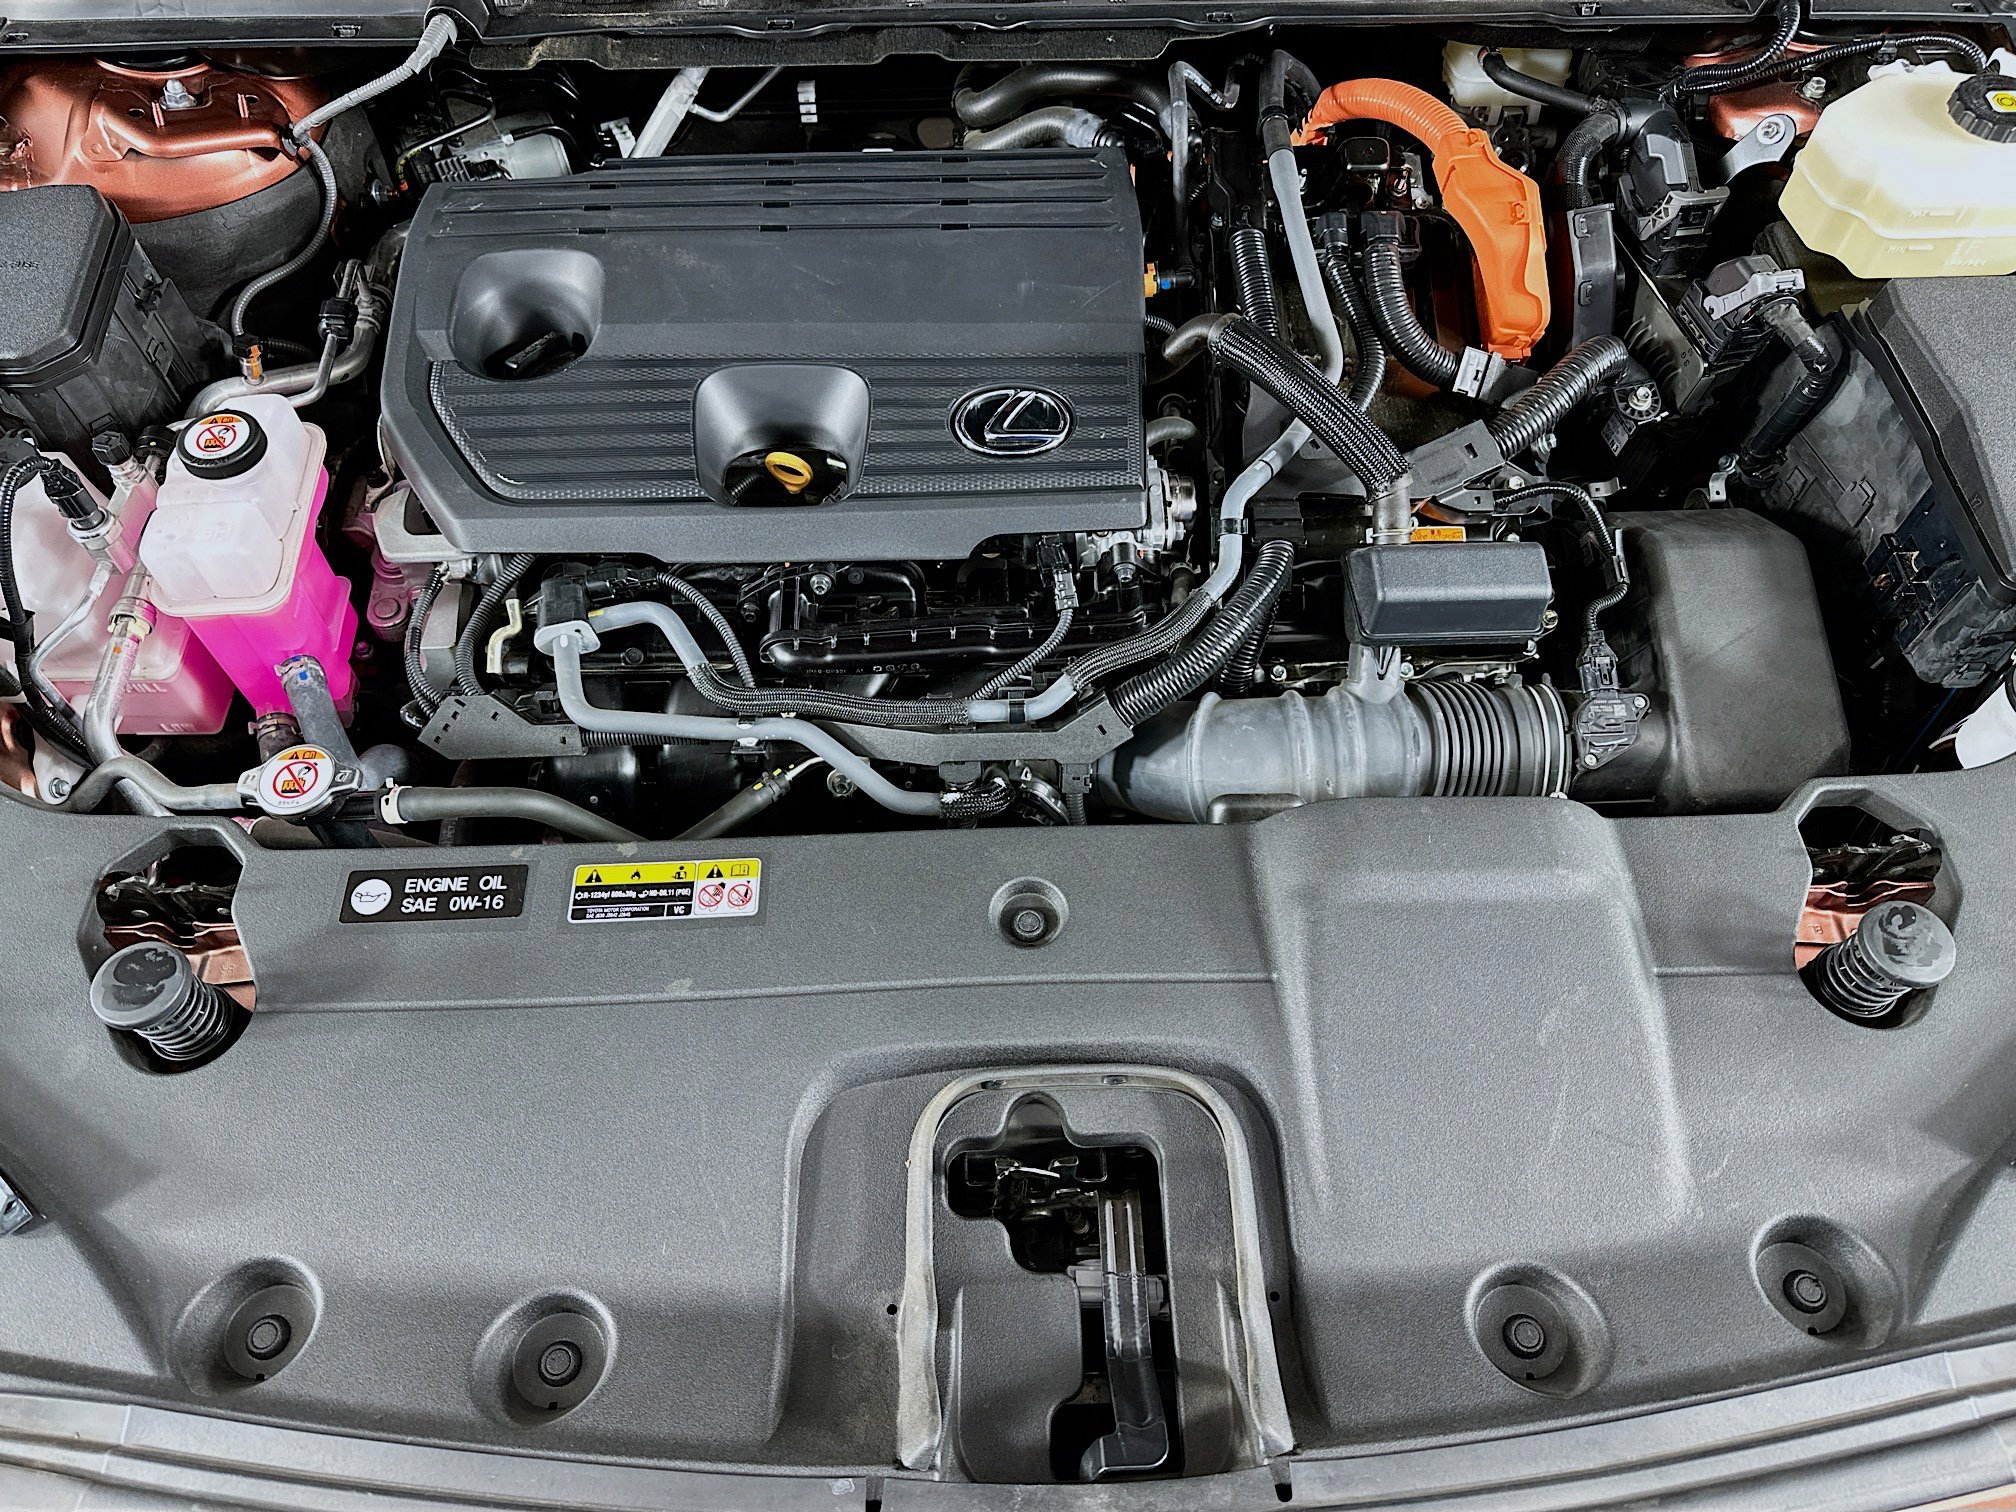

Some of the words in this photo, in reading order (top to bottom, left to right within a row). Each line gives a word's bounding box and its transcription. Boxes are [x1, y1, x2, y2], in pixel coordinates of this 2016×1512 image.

[404, 877, 470, 893] ENGINE
[479, 874, 508, 891] OIL
[401, 897, 438, 913] SAE
[449, 895, 505, 911] 0W-16
[673, 905, 685, 915] VC
